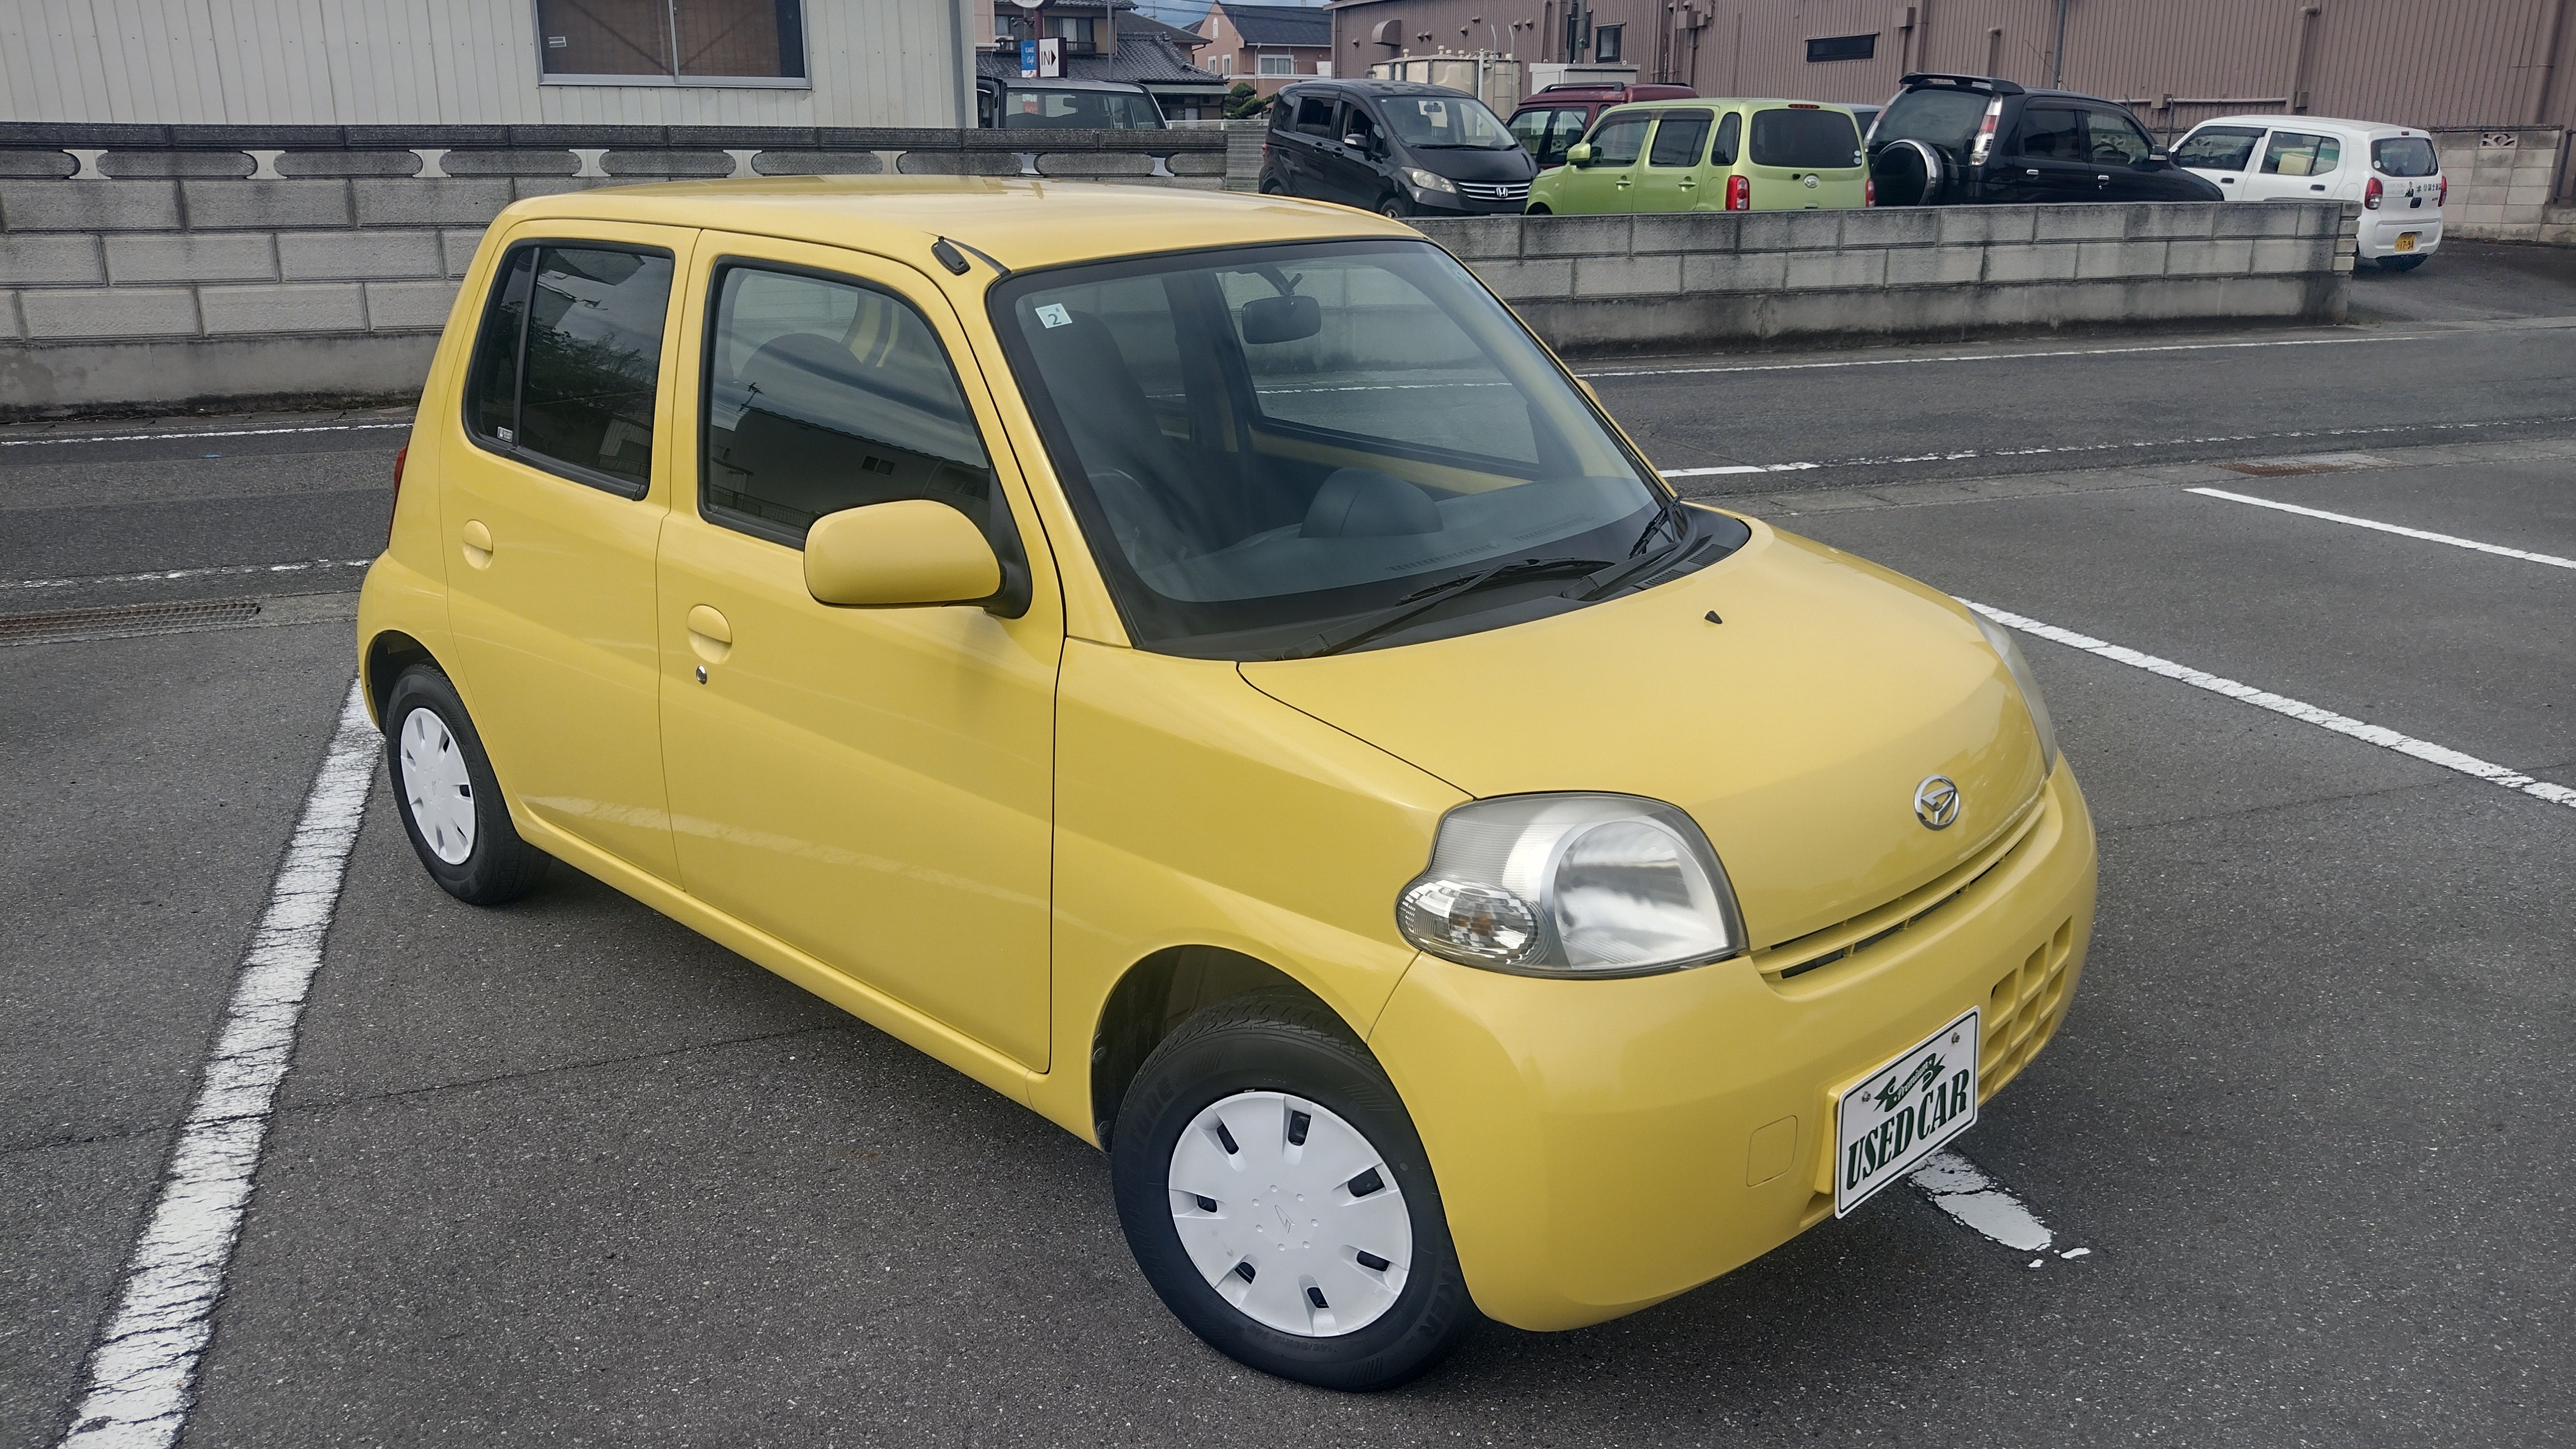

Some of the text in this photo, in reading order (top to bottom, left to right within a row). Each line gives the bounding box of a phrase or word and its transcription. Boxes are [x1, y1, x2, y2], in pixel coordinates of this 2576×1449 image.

[1041, 51, 1050, 66] IN
[1048, 314, 1062, 325] 2
[1846, 1069, 1969, 1190] USED CAR
